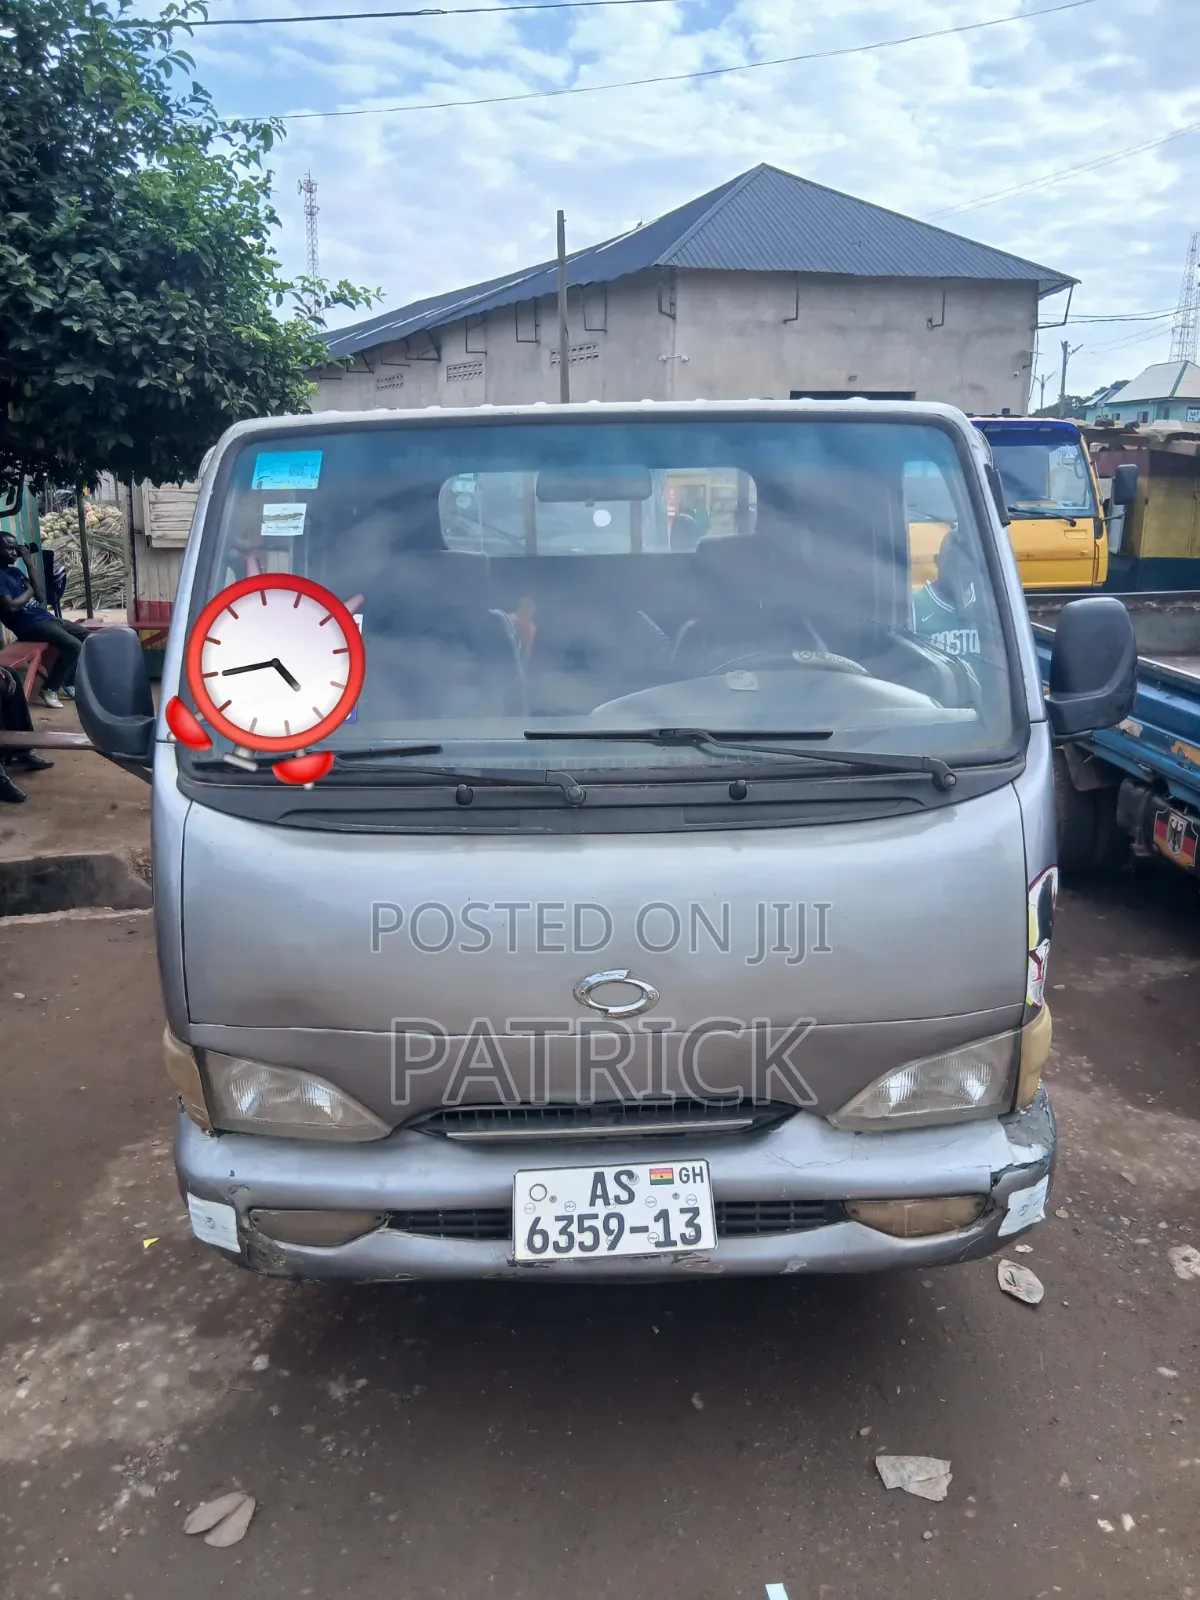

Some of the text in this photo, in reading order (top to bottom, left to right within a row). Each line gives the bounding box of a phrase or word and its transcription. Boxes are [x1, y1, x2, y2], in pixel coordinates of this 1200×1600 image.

[589, 1169, 635, 1207] AS
[678, 1165, 705, 1184] GH
[527, 1206, 702, 1254] 6359-13
